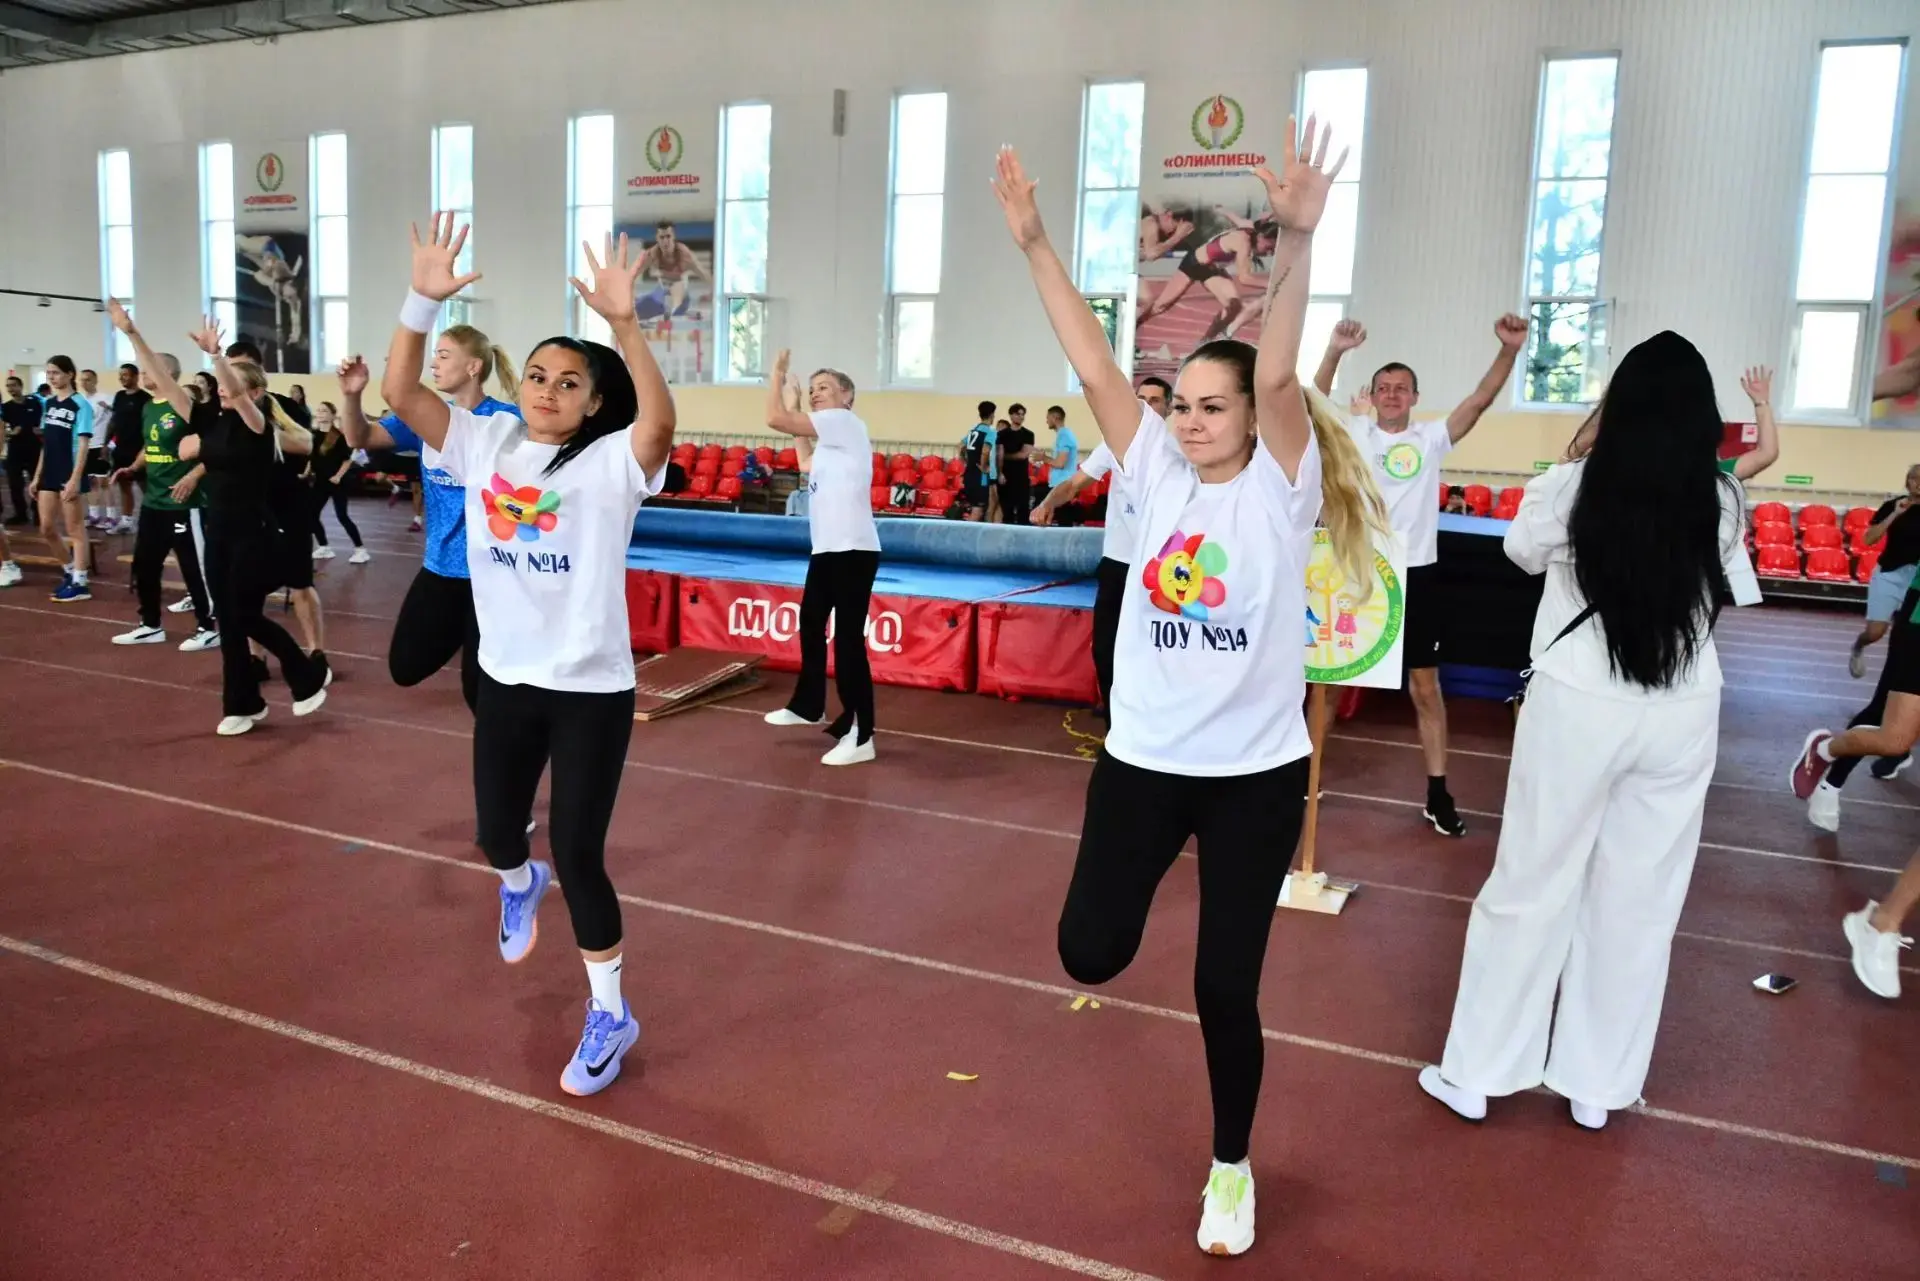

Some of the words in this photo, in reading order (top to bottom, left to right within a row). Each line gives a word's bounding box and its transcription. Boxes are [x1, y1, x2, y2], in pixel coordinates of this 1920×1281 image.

[1163, 153, 1266, 168] «ОЛИМПИЕЦ»
[627, 174, 700, 187] «ОЛИМПИЕЦ»
[527, 551, 570, 573] №14
[728, 597, 902, 652] MOO
[1150, 620, 1192, 652] ДОУ
[1201, 623, 1248, 652] №14
